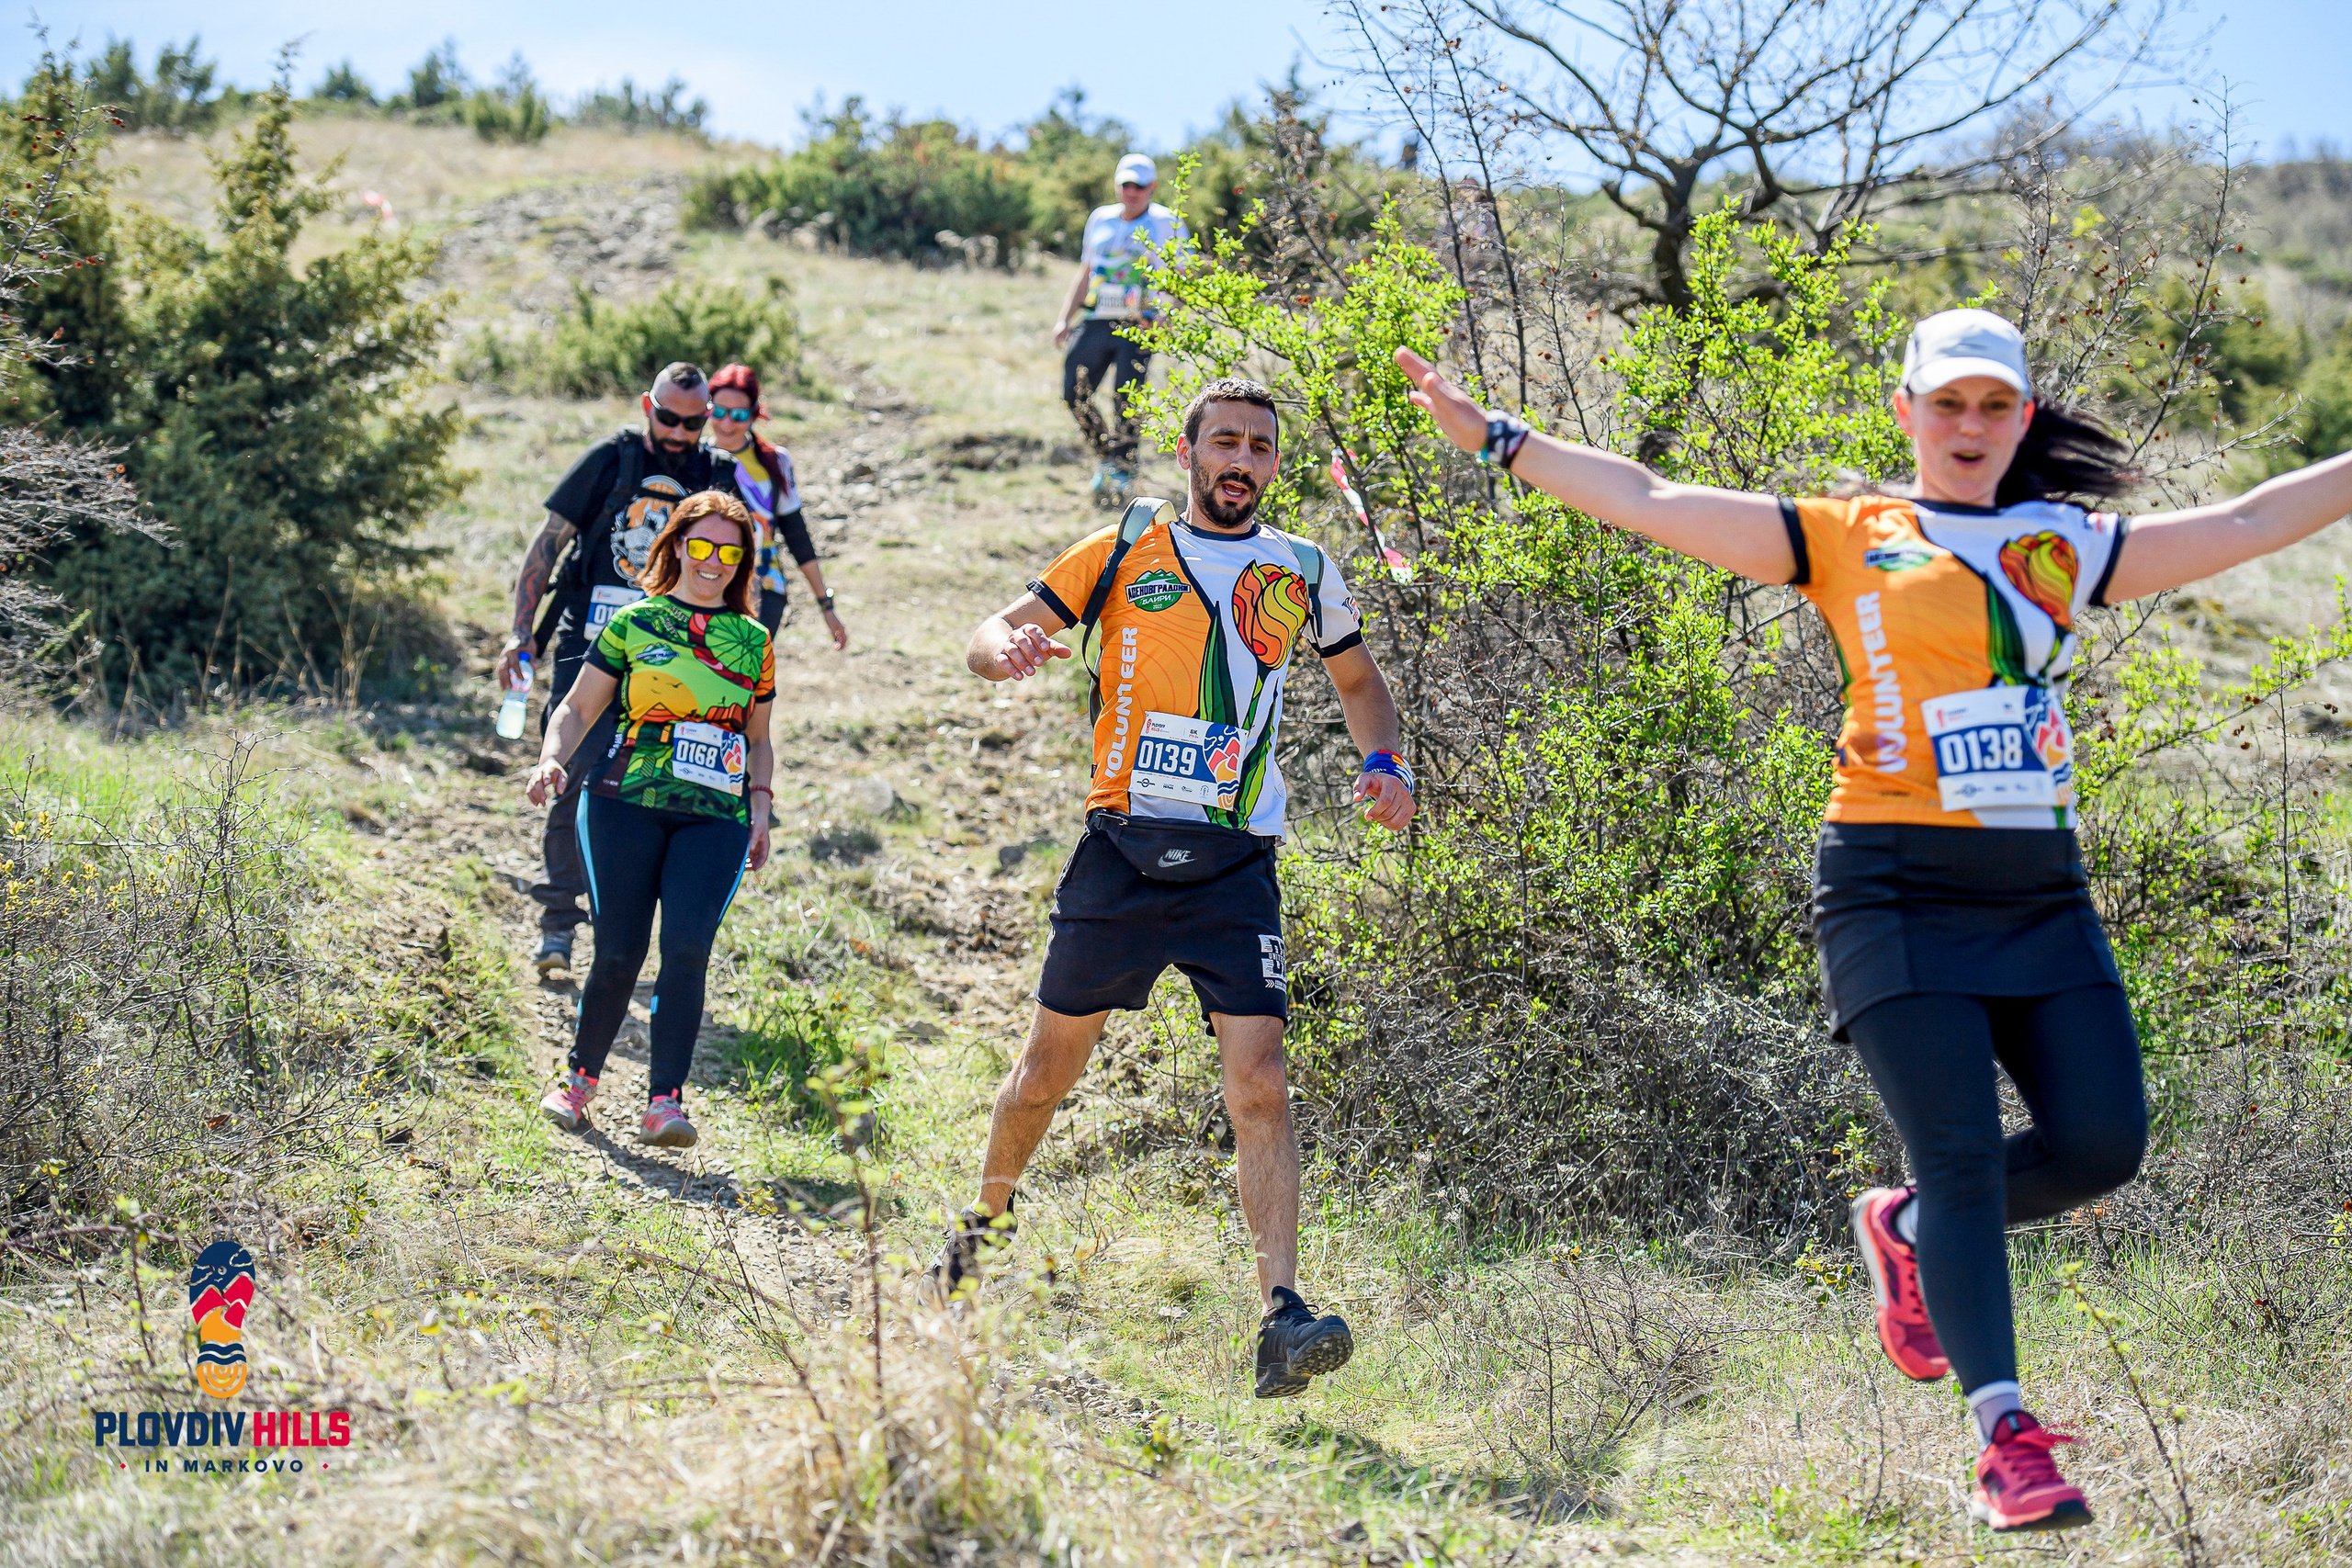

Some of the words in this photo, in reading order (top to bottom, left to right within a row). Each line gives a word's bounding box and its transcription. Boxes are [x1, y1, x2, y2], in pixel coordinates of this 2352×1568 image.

[675, 739, 718, 769] 0168
[1137, 740, 1198, 776] 0139
[1939, 727, 2023, 773] 0138
[1164, 848, 1192, 862] NIKE
